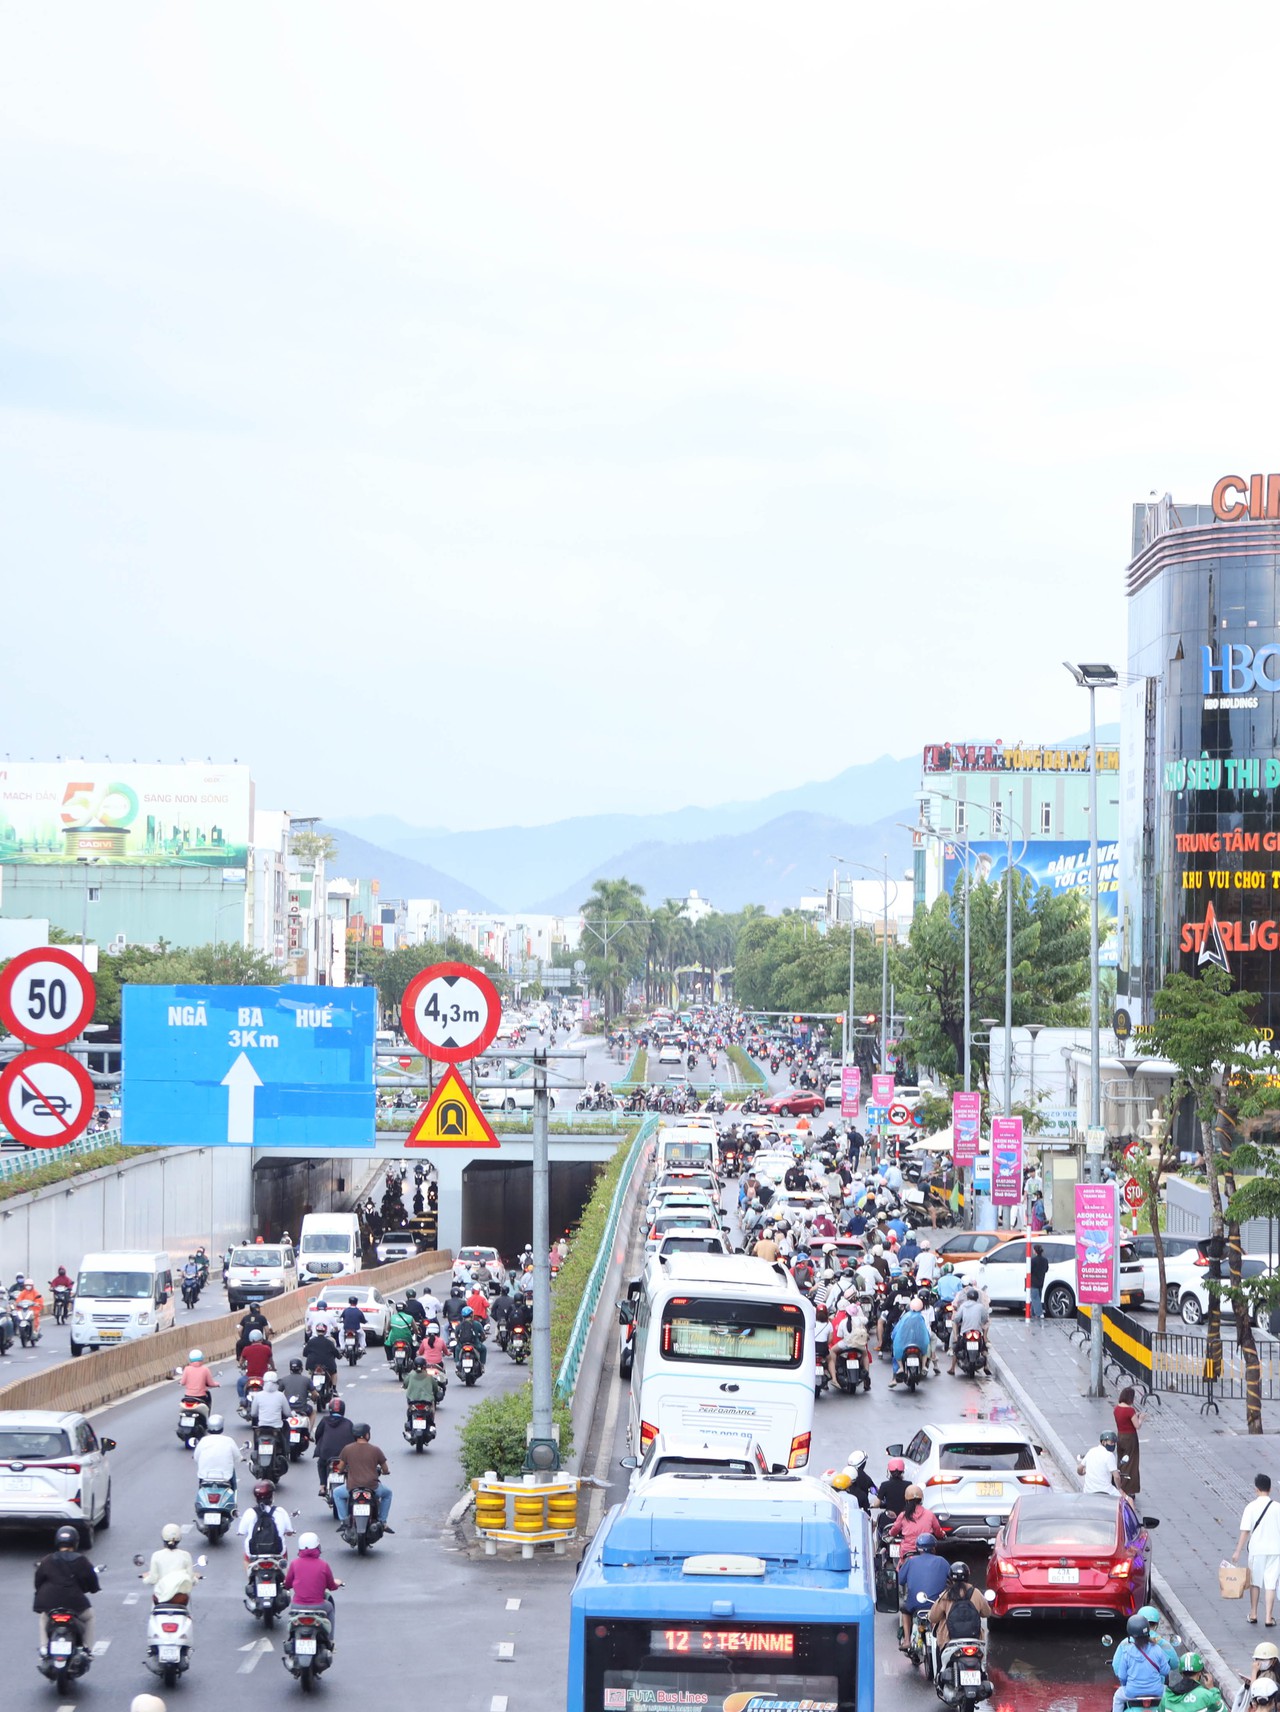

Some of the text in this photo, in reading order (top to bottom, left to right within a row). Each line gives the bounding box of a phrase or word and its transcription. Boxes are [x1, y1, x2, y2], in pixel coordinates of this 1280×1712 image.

[1220, 697, 1259, 710] HOLDINGS
[1163, 757, 1187, 799] CHỢ
[1187, 750, 1222, 791] SIÊU
[1224, 759, 1260, 797] THỊ
[79, 840, 113, 849] CADIVI
[1176, 832, 1221, 852] TRUNG
[1222, 827, 1260, 852] TÂM
[1182, 871, 1203, 889] KHU
[1208, 870, 1230, 889] VUI
[1234, 870, 1266, 889] CHƠI
[28, 978, 67, 1020] 50
[168, 1000, 333, 1027] NGÃ BA HUẾ
[424, 993, 480, 1027] 4,3m
[228, 1029, 279, 1048] 3Km
[698, 1407, 757, 1416] PERFORMANCE
[665, 1630, 689, 1650] 12
[626, 1689, 708, 1704] FUTA Bus Lines
